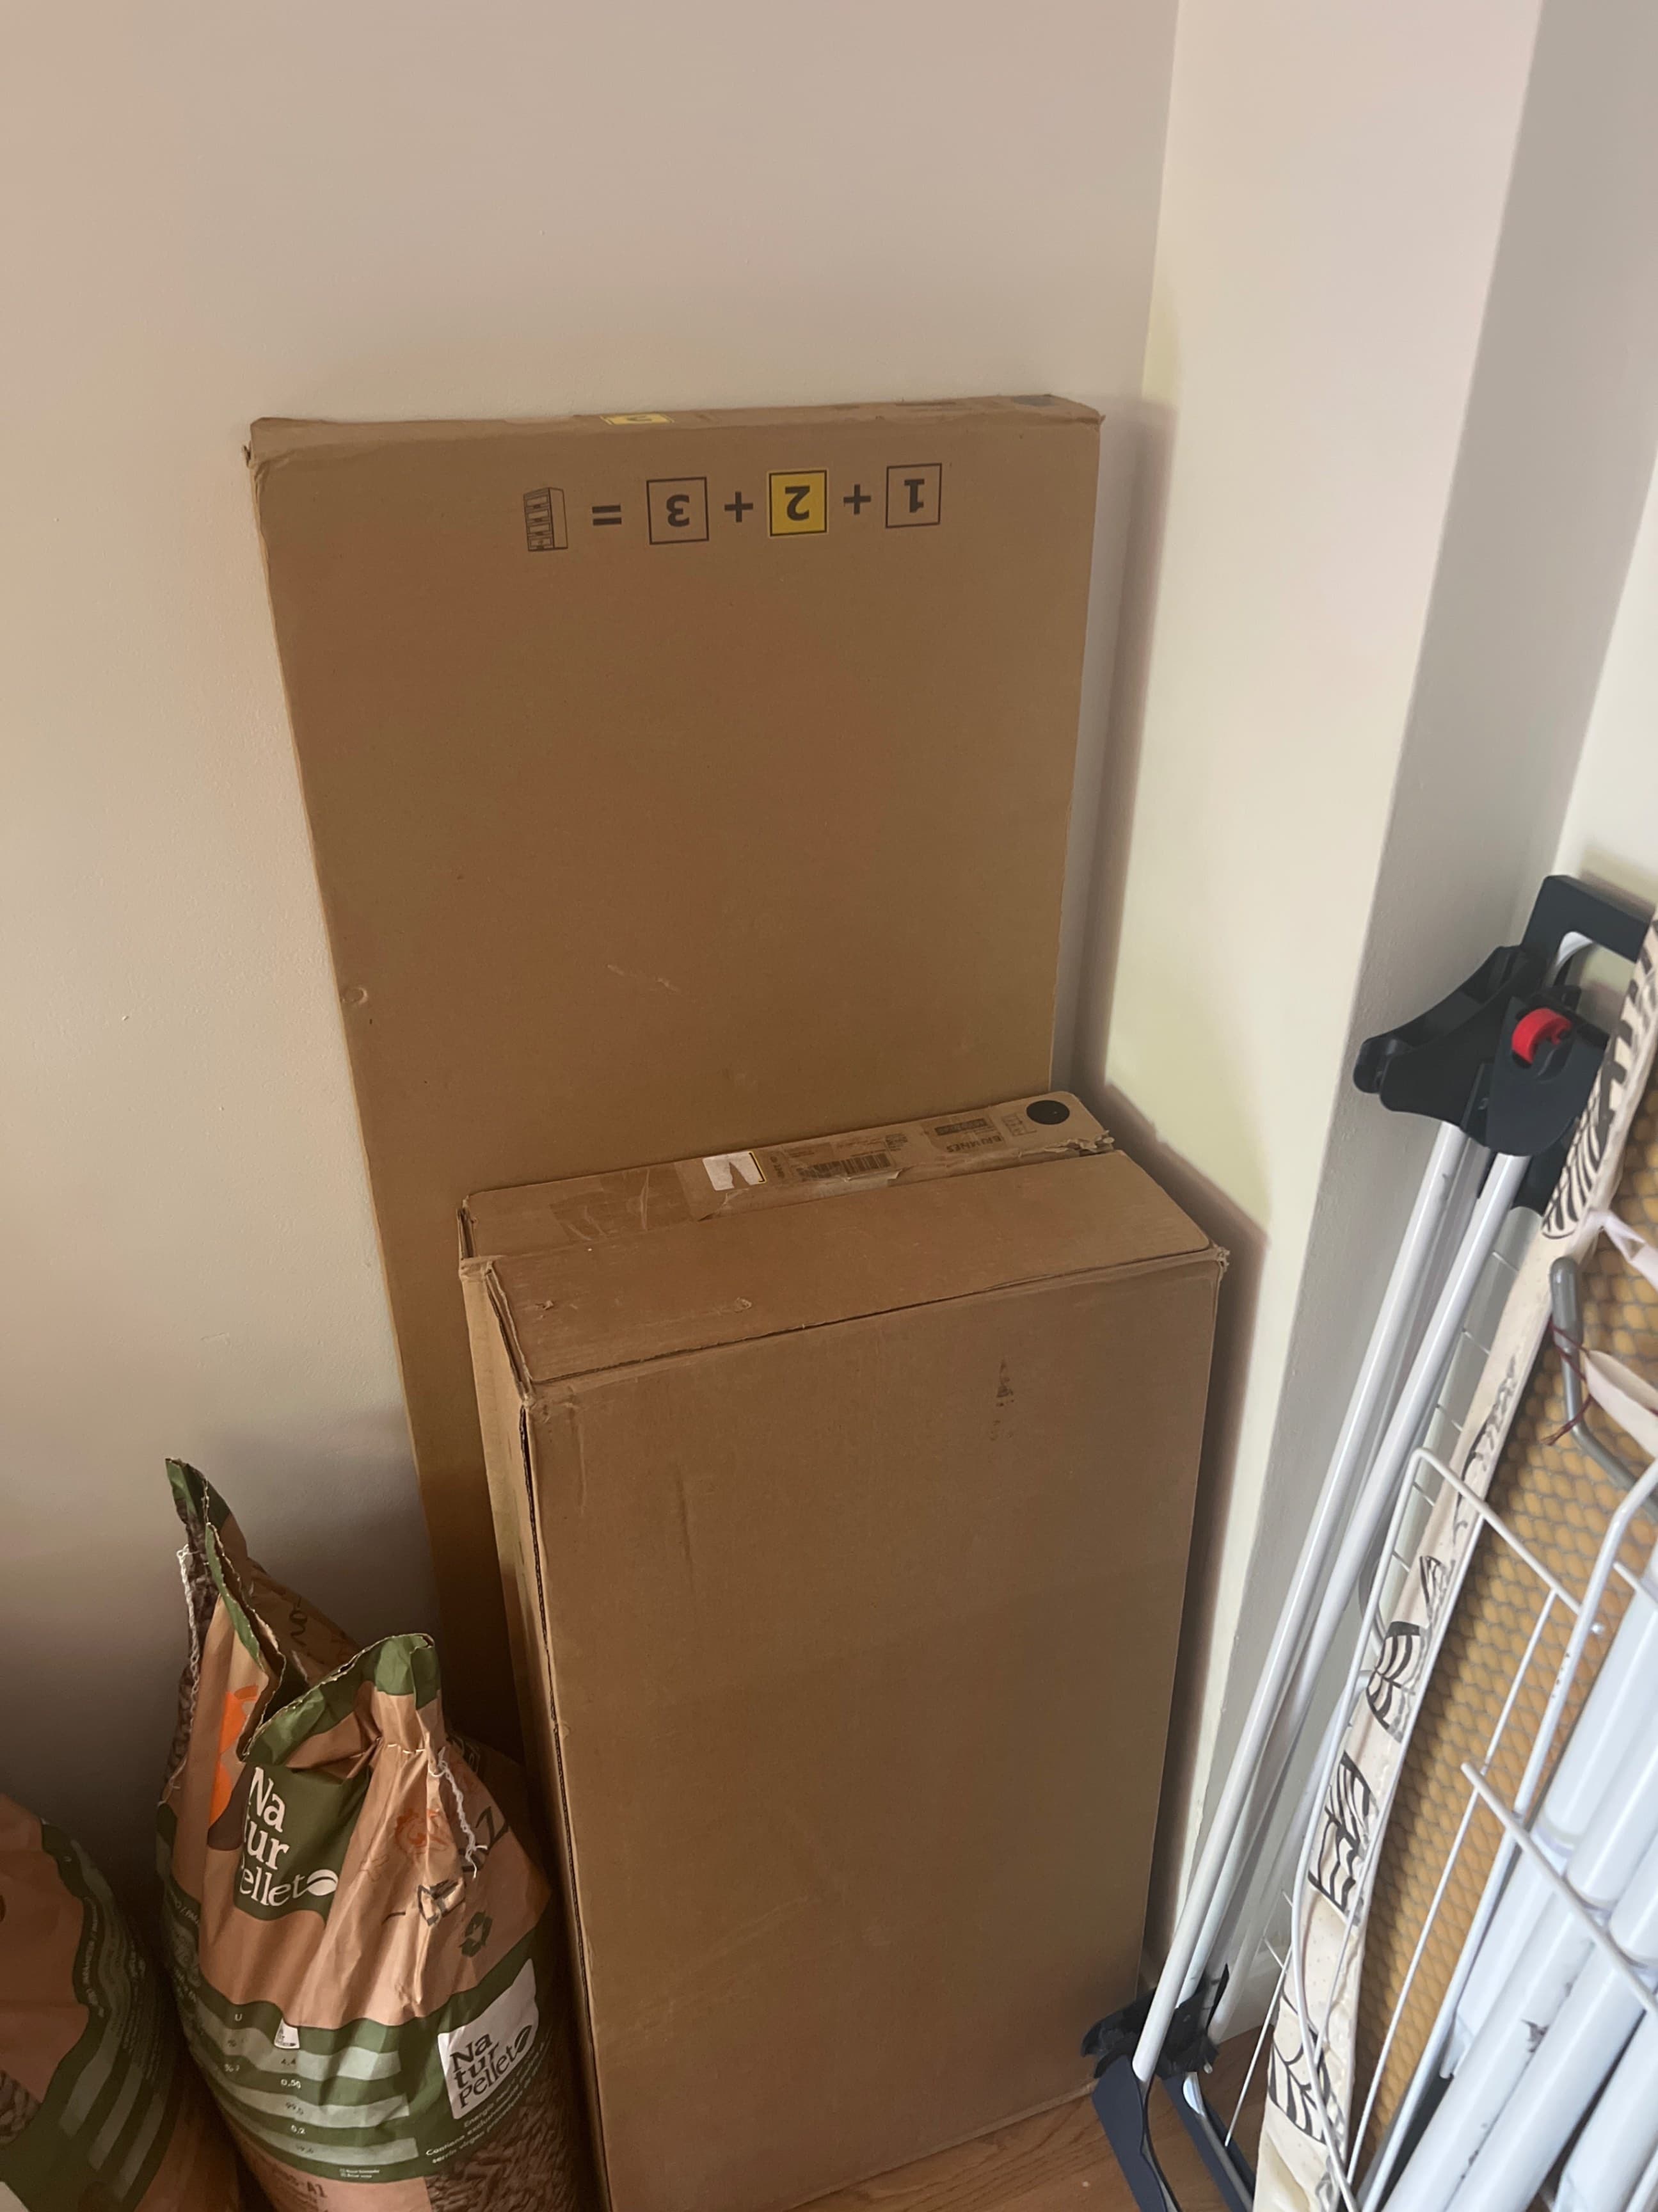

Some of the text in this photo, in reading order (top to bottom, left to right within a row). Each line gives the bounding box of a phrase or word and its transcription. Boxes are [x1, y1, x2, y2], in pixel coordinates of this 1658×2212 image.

[666, 494, 690, 528] 3
[784, 485, 811, 522] 2
[904, 479, 925, 515] 1
[249, 1767, 285, 1832] Na
[244, 1813, 289, 1870] ur
[240, 1867, 307, 1907] ellet
[450, 2033, 493, 2073] Na
[455, 2042, 500, 2089] tur
[459, 2045, 518, 2109] Pellet
